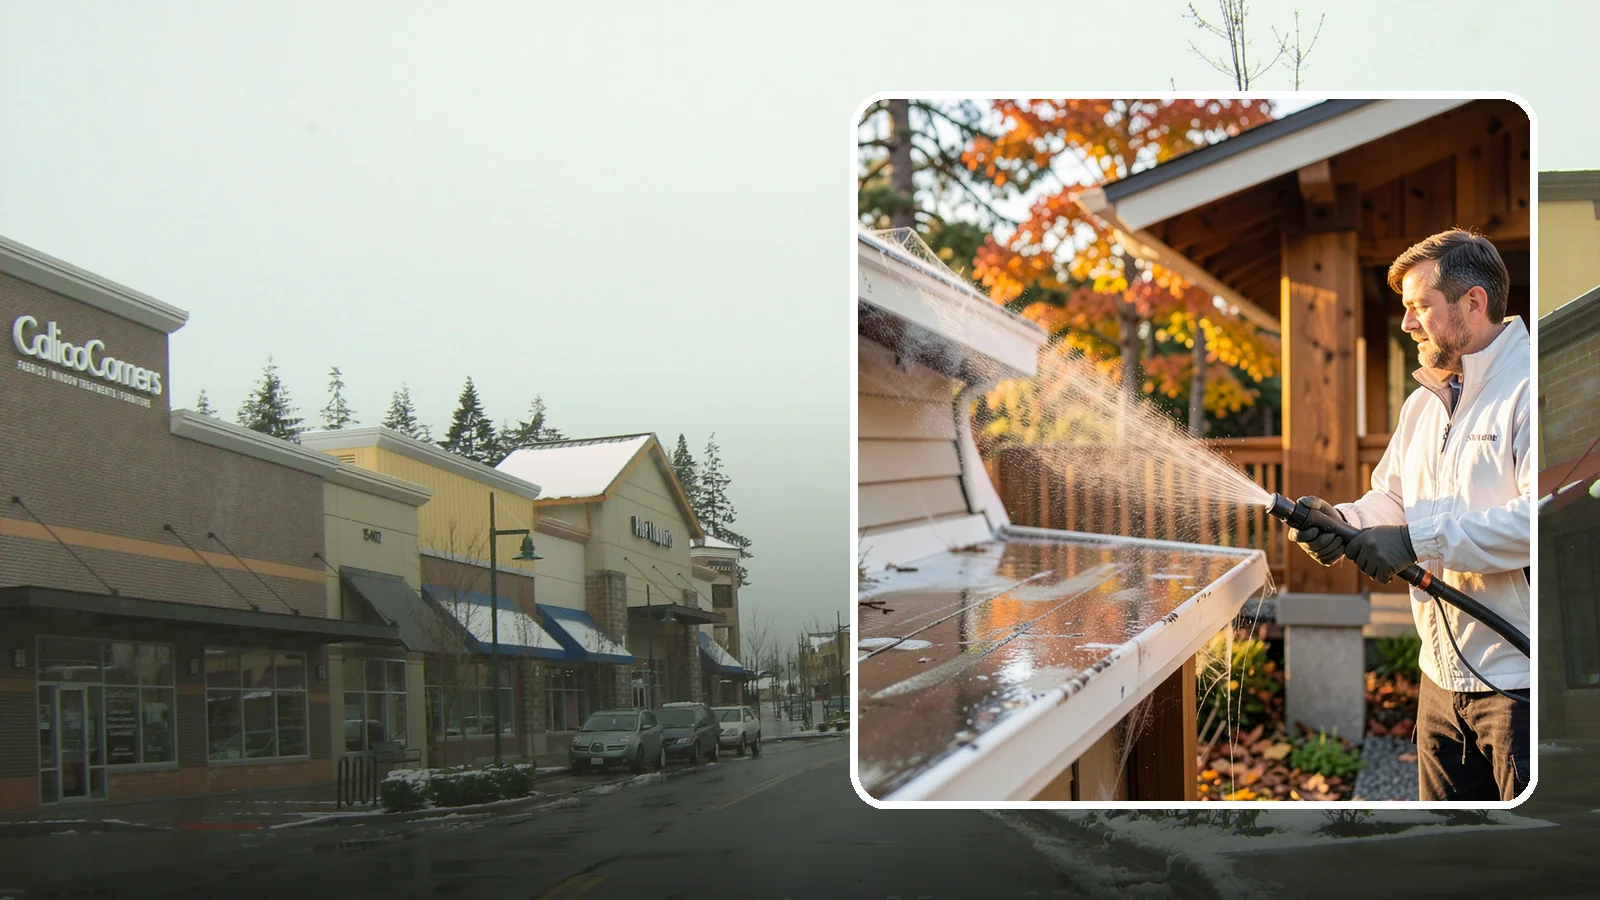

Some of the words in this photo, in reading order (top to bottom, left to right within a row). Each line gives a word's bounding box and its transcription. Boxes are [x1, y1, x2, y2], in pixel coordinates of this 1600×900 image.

[16, 360, 47, 378] FABRICS
[51, 370, 78, 386] WINDOW
[78, 378, 116, 398] TREATMENTS
[120, 391, 151, 409] FURNITURE
